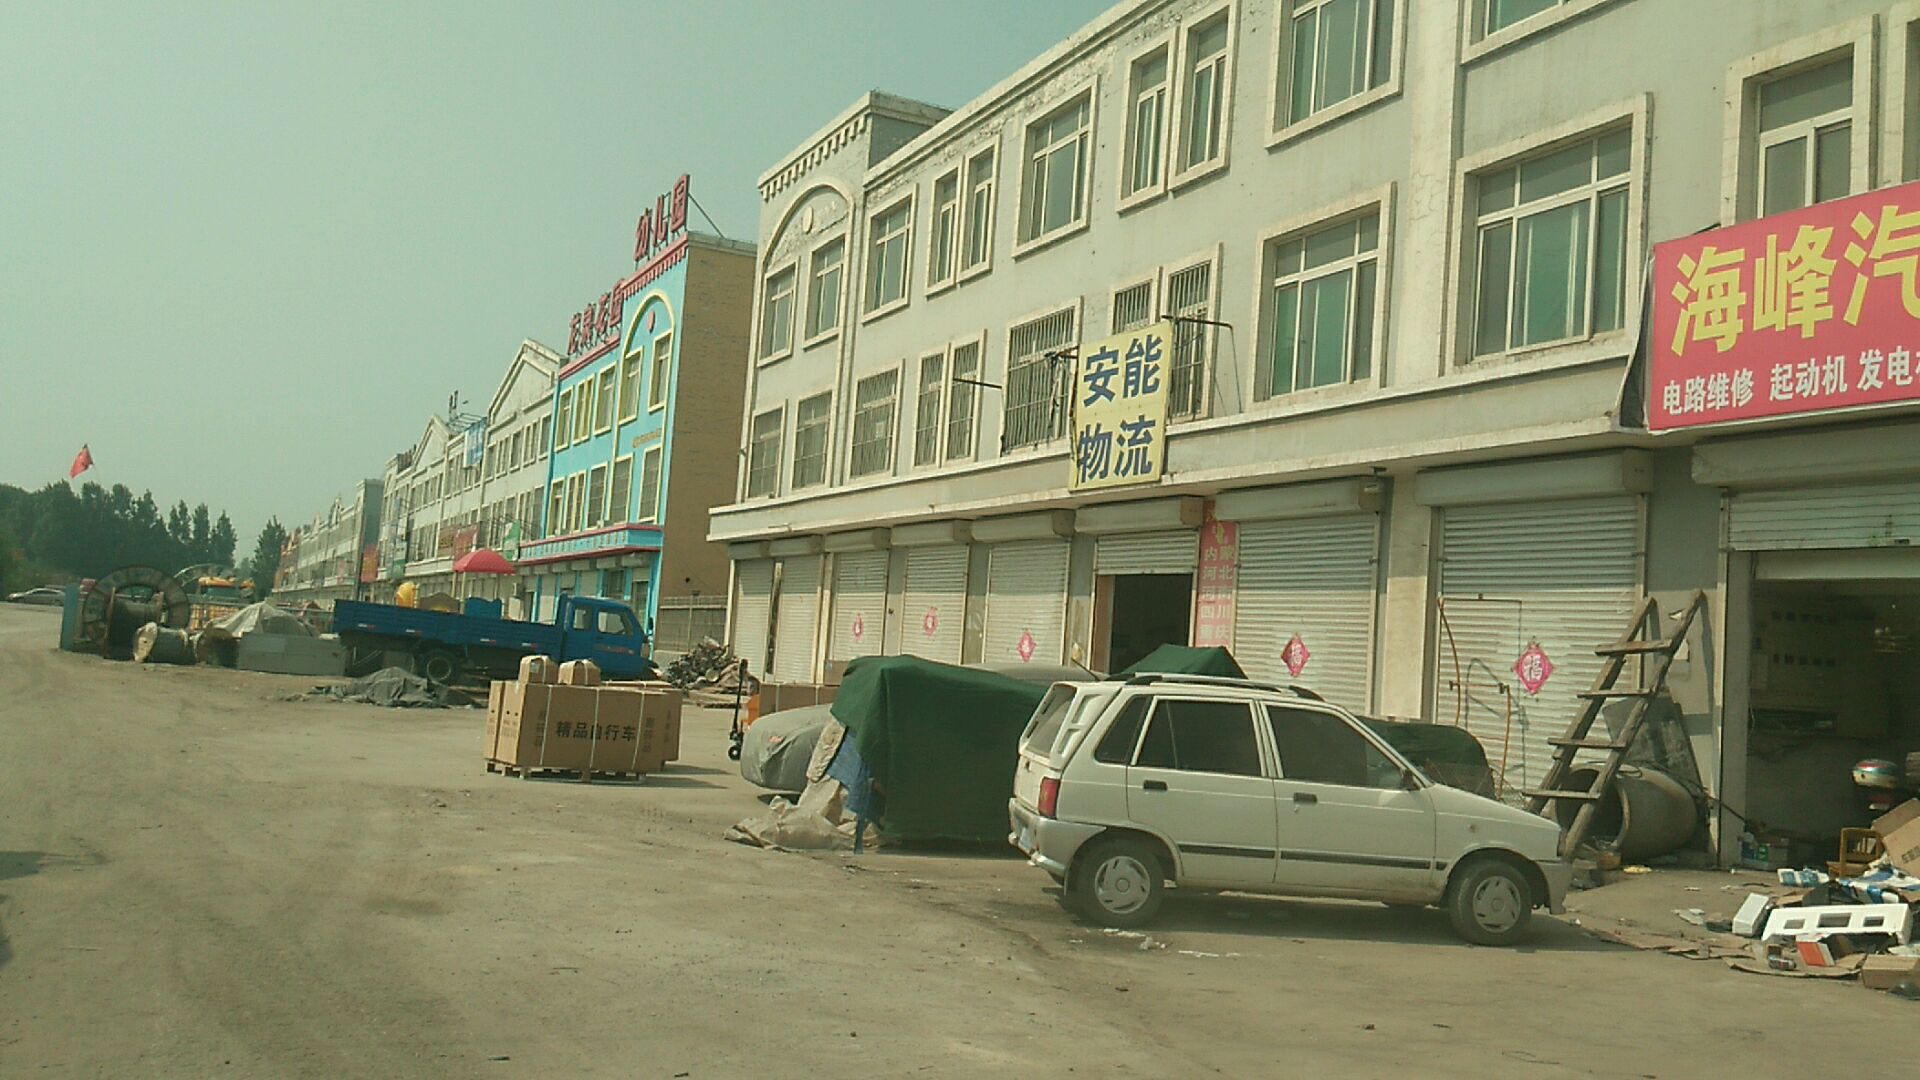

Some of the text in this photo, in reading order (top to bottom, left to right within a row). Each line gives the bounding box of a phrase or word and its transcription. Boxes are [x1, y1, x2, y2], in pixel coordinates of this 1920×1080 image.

[633, 173, 690, 262] 幼儿园
[1671, 204, 1920, 357] 海峰汽
[1083, 334, 1162, 407] 安能
[1662, 368, 1754, 415] 电路维修
[1769, 354, 1848, 401] 起动机
[1856, 345, 1920, 391] 发电
[1077, 414, 1156, 483] 物流
[556, 721, 637, 741] 精品自行车
